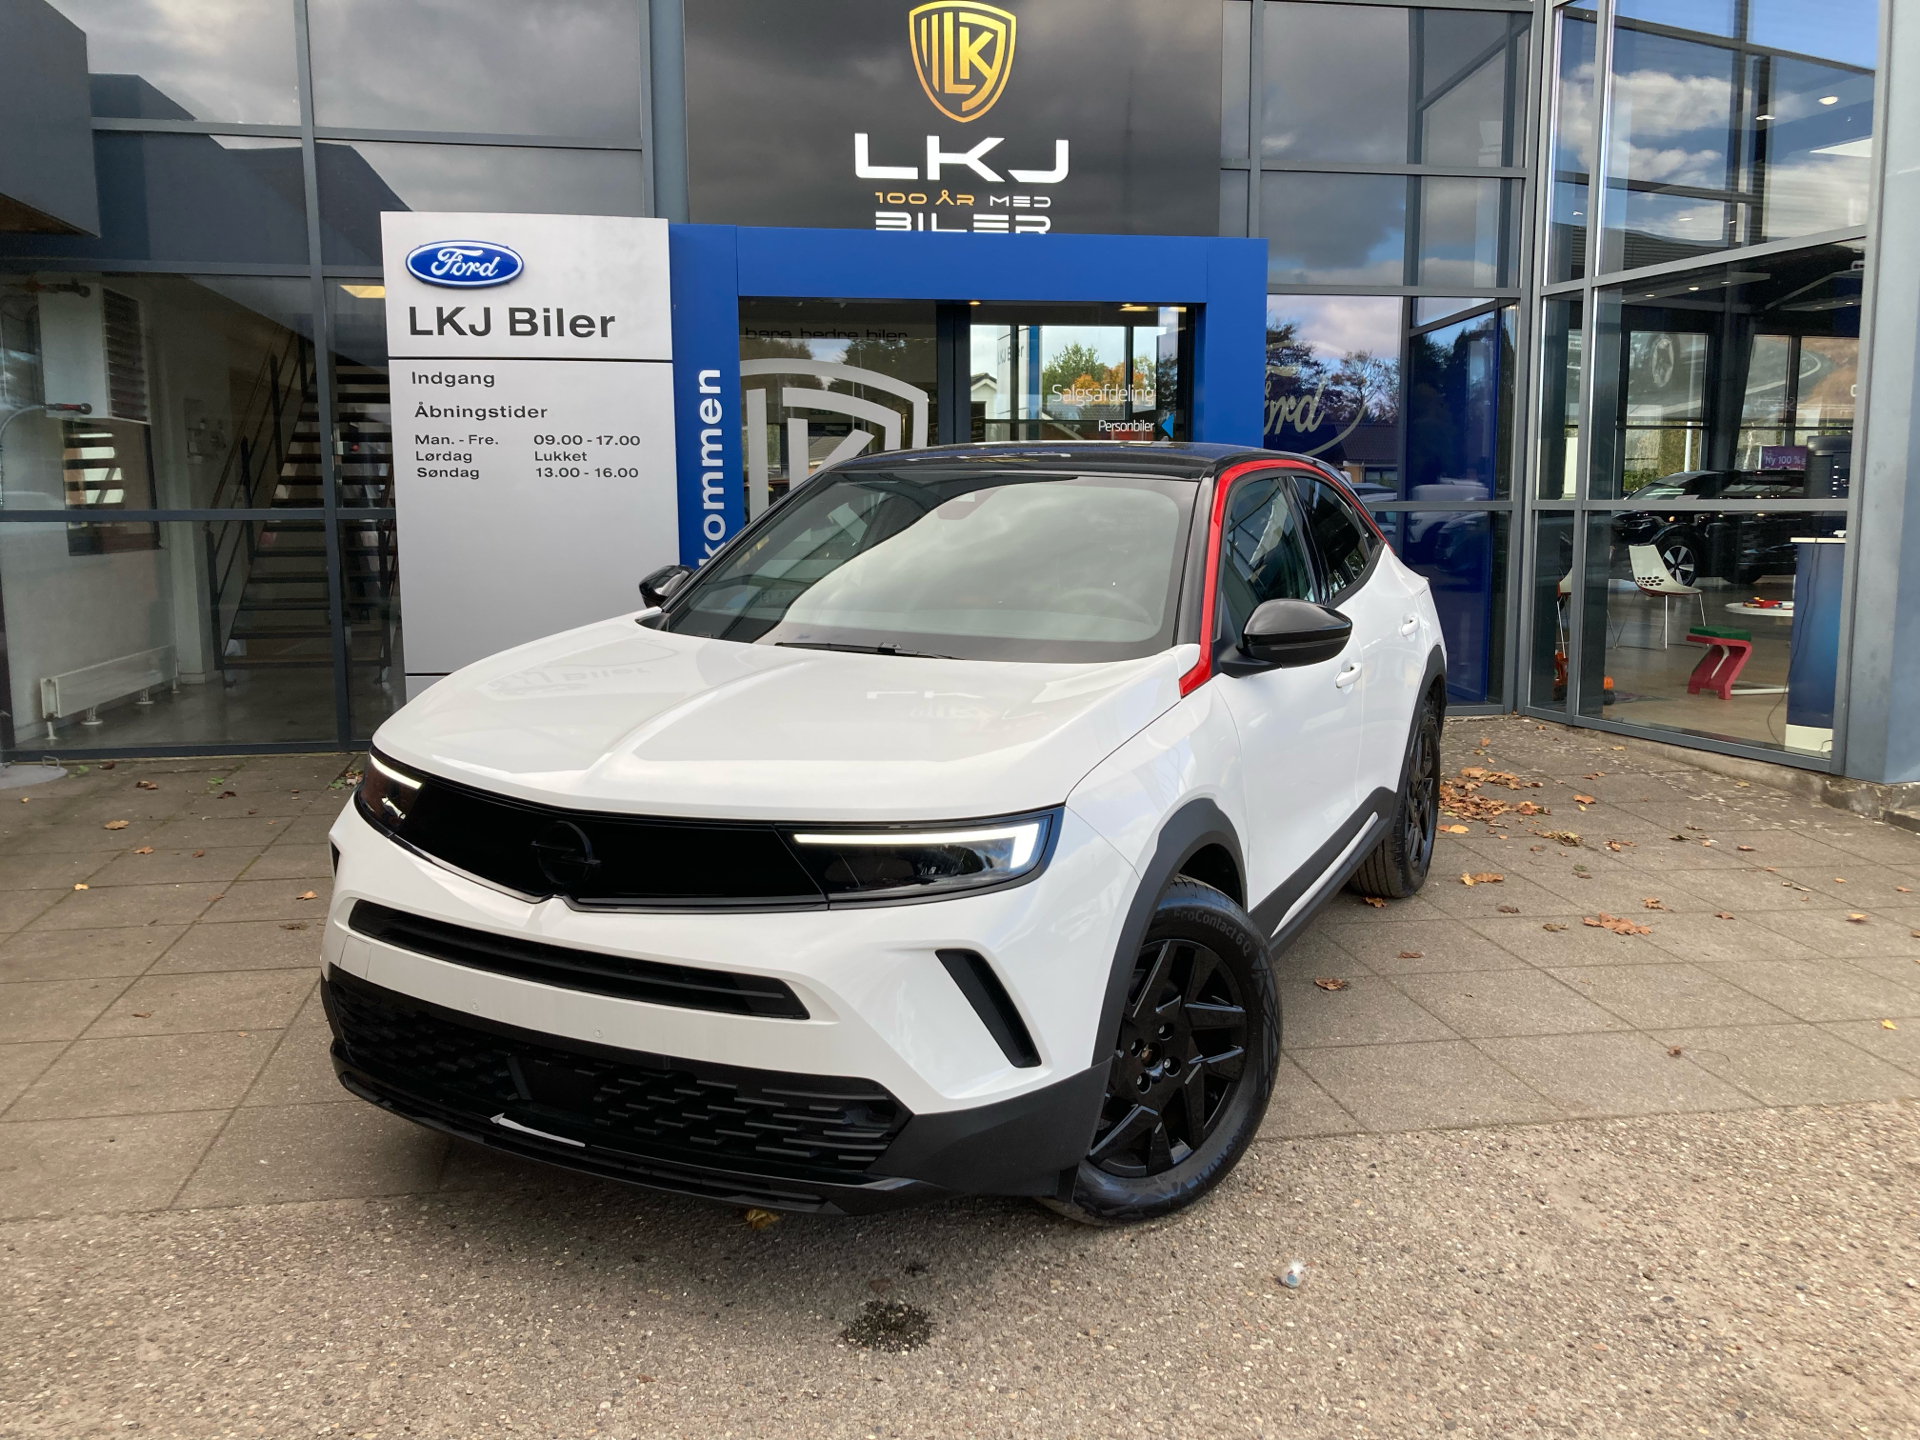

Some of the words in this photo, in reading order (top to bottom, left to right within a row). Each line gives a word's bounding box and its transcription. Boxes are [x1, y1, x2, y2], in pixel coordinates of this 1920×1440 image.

[854, 132, 1070, 184] LKJ
[874, 190, 928, 205] 100
[935, 189, 975, 207] ÅR
[989, 195, 1052, 208] MED
[875, 211, 1052, 235] BILER
[430, 246, 499, 278] Ford
[408, 305, 492, 338] LKJ
[507, 306, 617, 339] Biler
[411, 371, 496, 388] Indgang
[1052, 383, 1156, 407] Salgsafdeling
[414, 401, 548, 422] Åbningstider
[1098, 419, 1155, 433] Personbiler
[414, 434, 455, 446] Man.
[468, 434, 499, 446] Fre.
[533, 434, 583, 446] 09.00
[596, 434, 641, 446] 17.00
[415, 450, 473, 464] Lørdag
[534, 450, 588, 463] Lukket
[416, 467, 480, 480] Søndag
[535, 467, 581, 479] 13.00
[594, 467, 639, 479] 16.00
